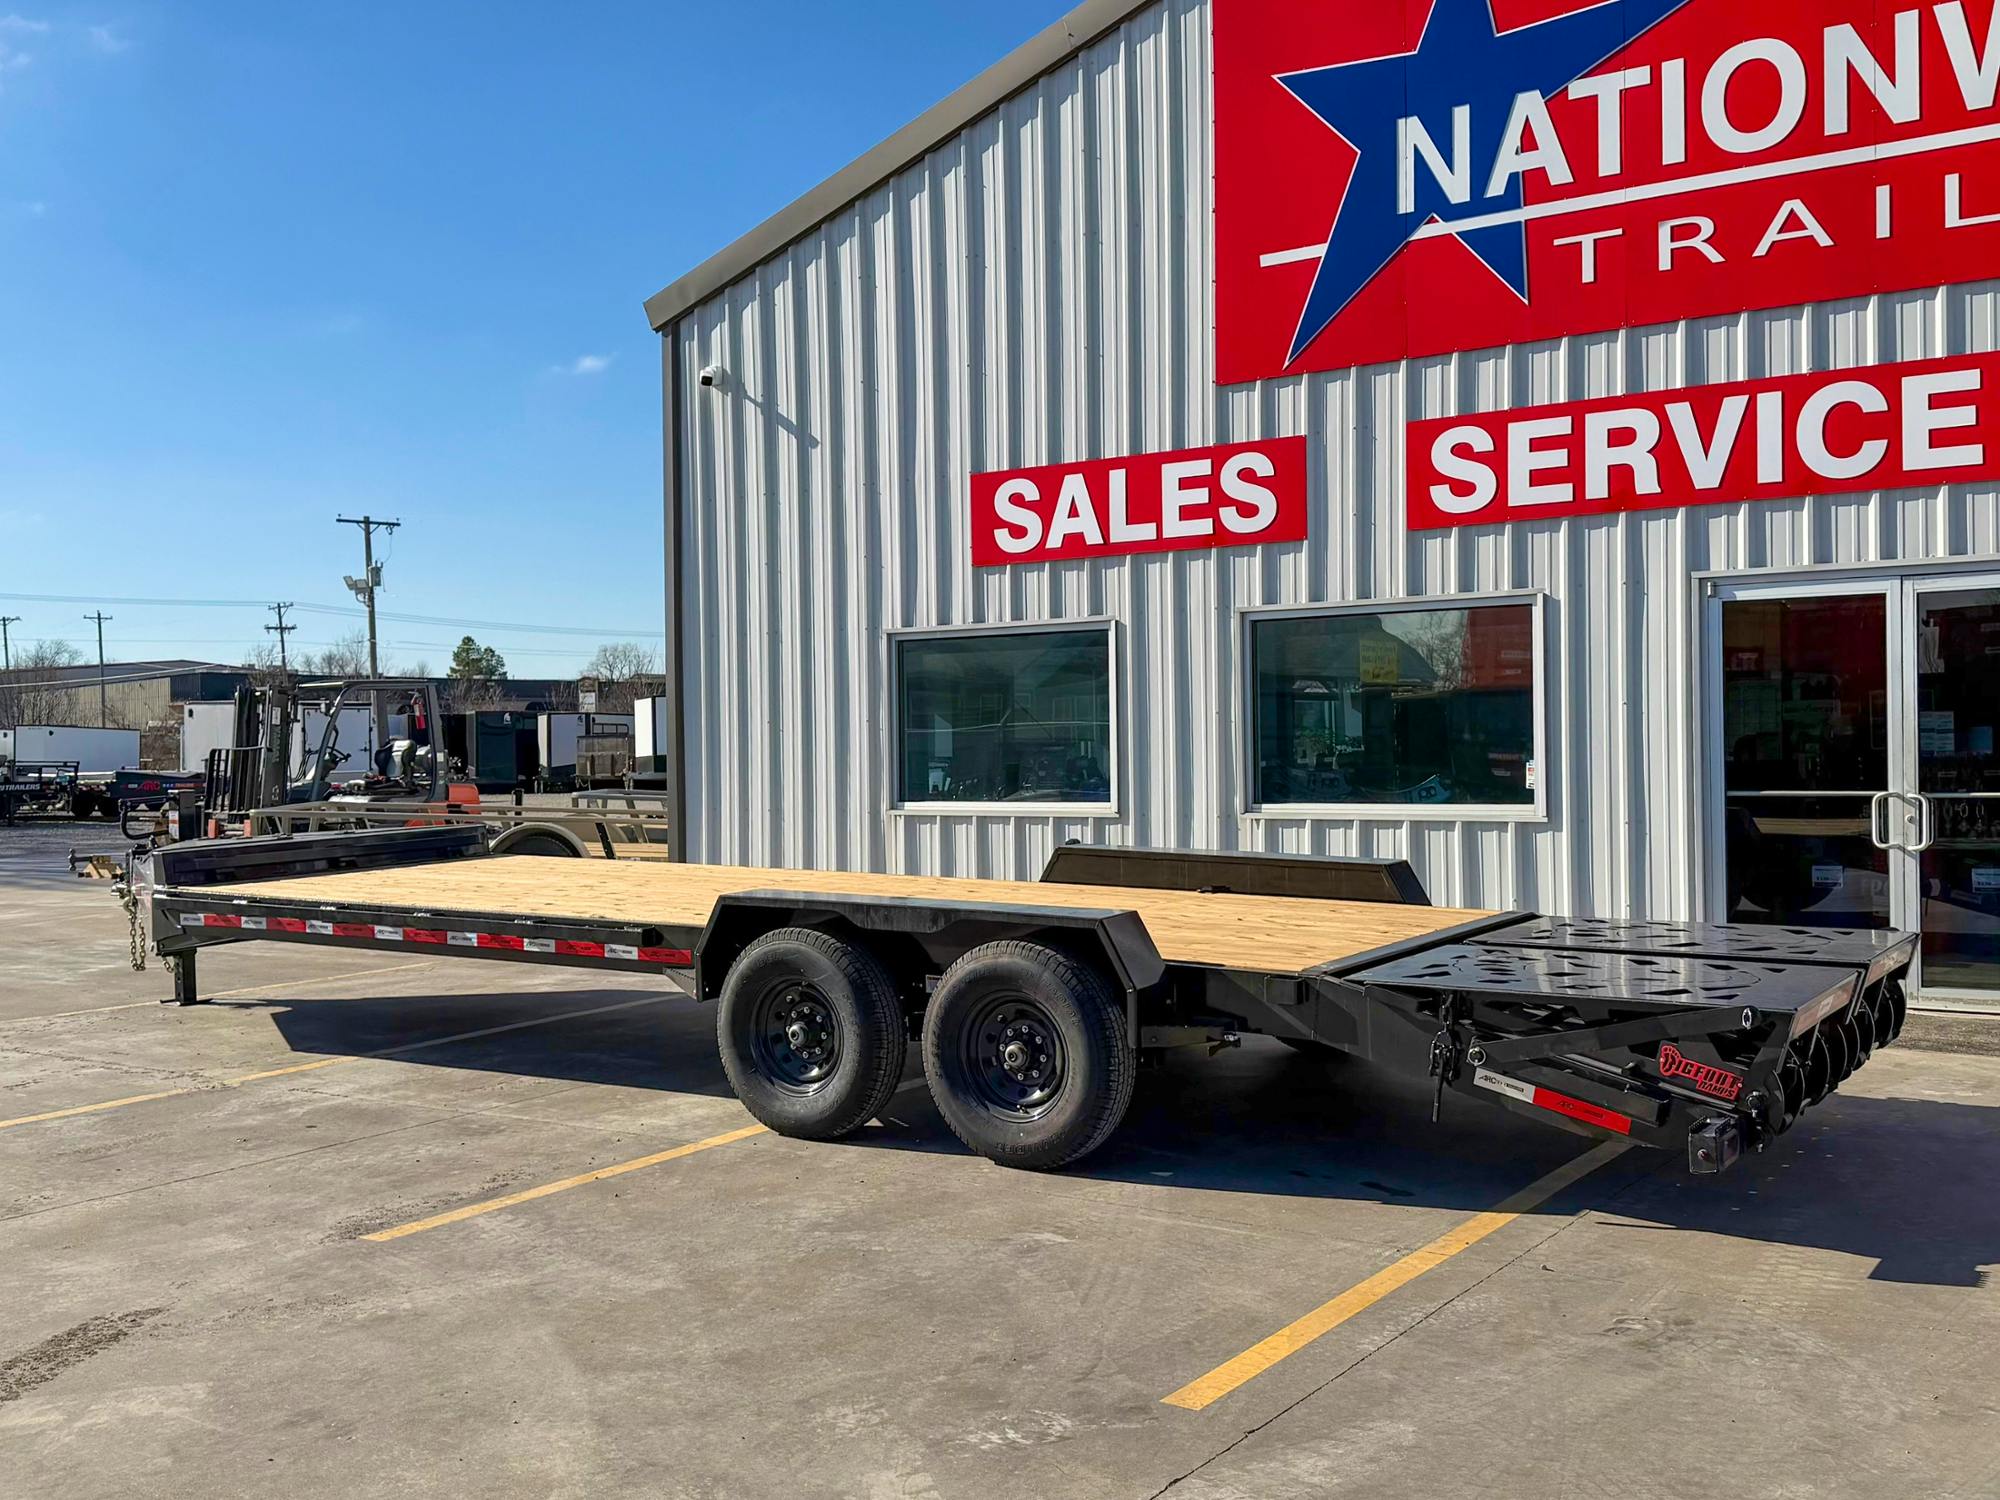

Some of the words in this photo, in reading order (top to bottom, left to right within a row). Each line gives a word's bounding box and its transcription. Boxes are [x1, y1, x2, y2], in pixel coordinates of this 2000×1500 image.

[1554, 173, 2000, 283] TRAIL
[1429, 368, 1984, 514] SERVICE
[993, 451, 1278, 554] SALES
[5, 783, 41, 791] TRAILERS
